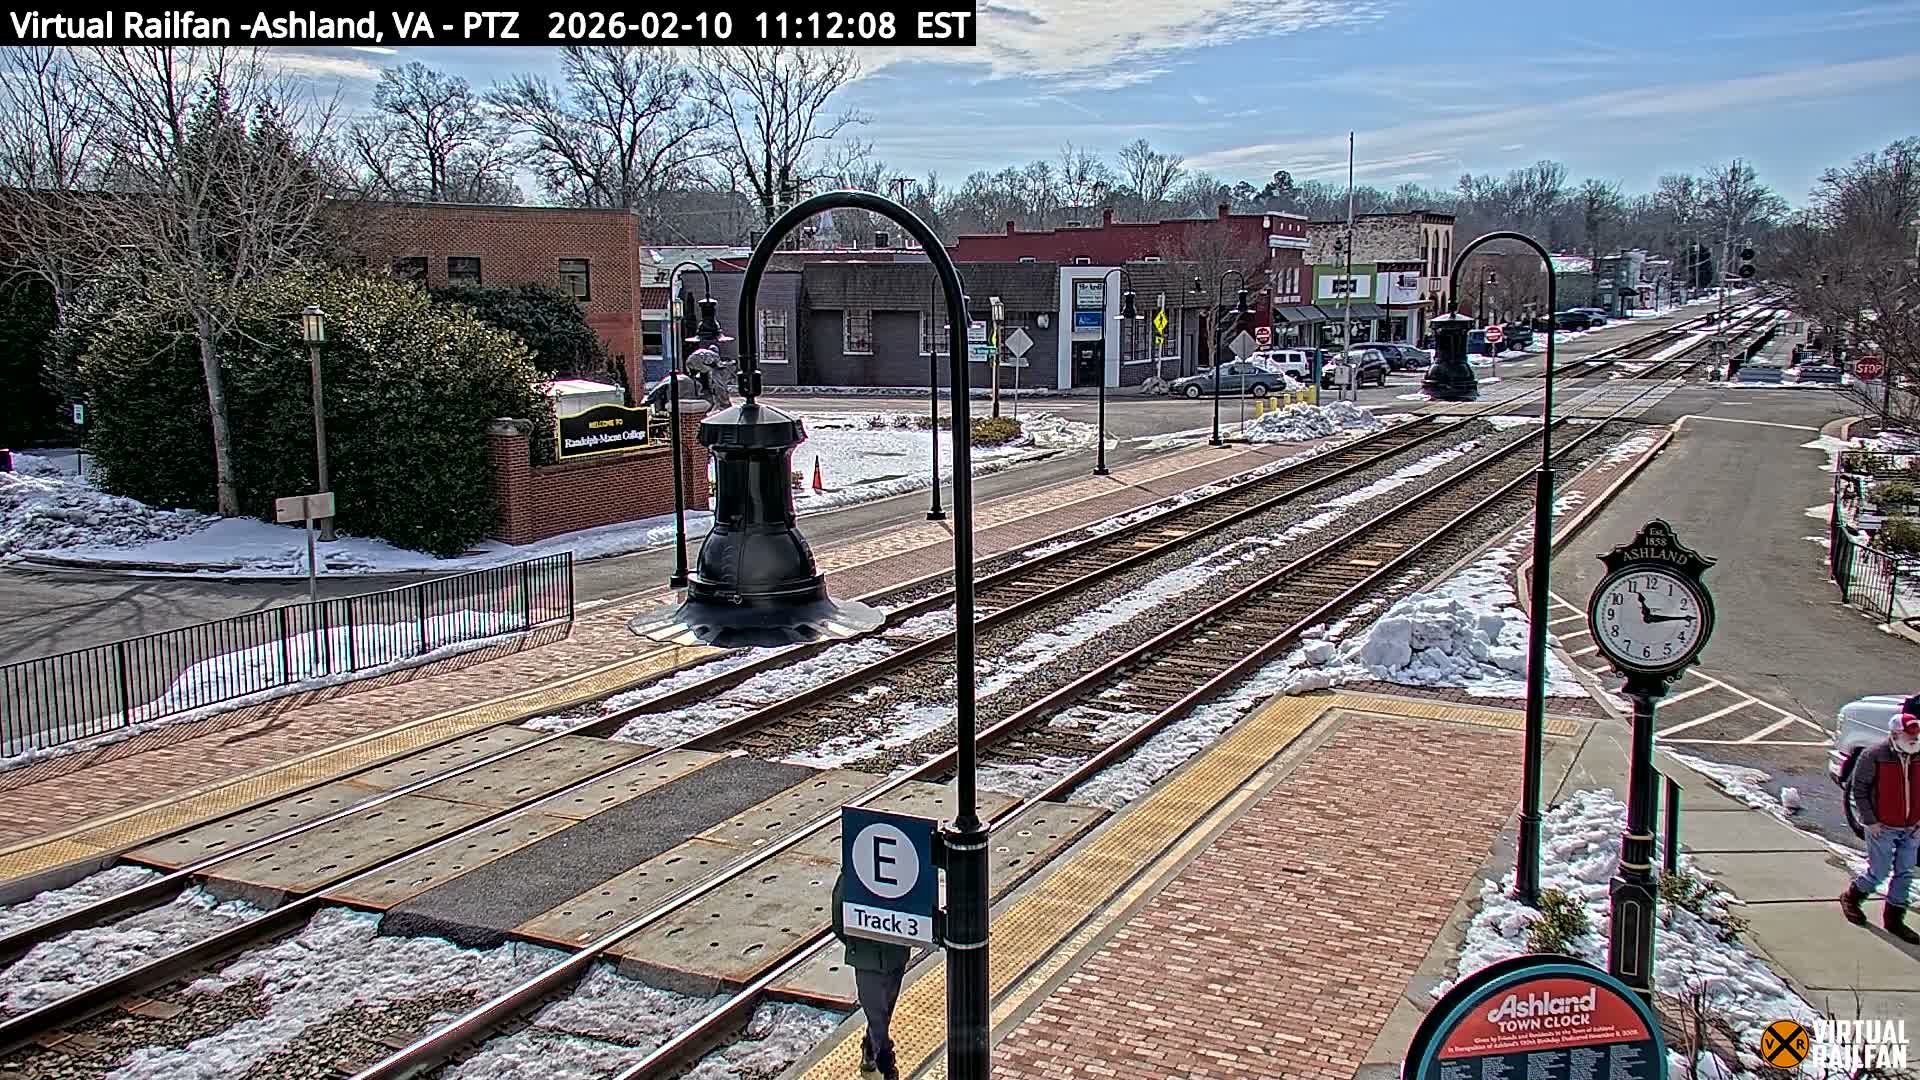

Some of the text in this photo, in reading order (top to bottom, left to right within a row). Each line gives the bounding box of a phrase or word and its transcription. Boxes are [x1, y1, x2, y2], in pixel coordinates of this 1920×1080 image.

[1856, 363, 1881, 374] STOP
[589, 418, 623, 428] WELCOME TO
[622, 430, 646, 440] College
[1645, 537, 1668, 546] 1858
[1623, 547, 1688, 565] ASHLAND
[1628, 581, 1637, 593] 11
[1646, 577, 1658, 590] 12
[1668, 584, 1673, 597] 1
[1611, 593, 1623, 605] 10
[1680, 598, 1688, 611] 2
[1607, 608, 1615, 620] 9
[1611, 625, 1619, 638] 8
[1677, 631, 1685, 641] 4
[1624, 640, 1631, 652] 7
[1643, 646, 1651, 658] 6
[1663, 643, 1672, 655] 5
[873, 836, 898, 886] E
[854, 908, 918, 936] Track 3
[1487, 987, 1598, 1023] Ashland
[1498, 1014, 1590, 1033] TOWN CLOCK
